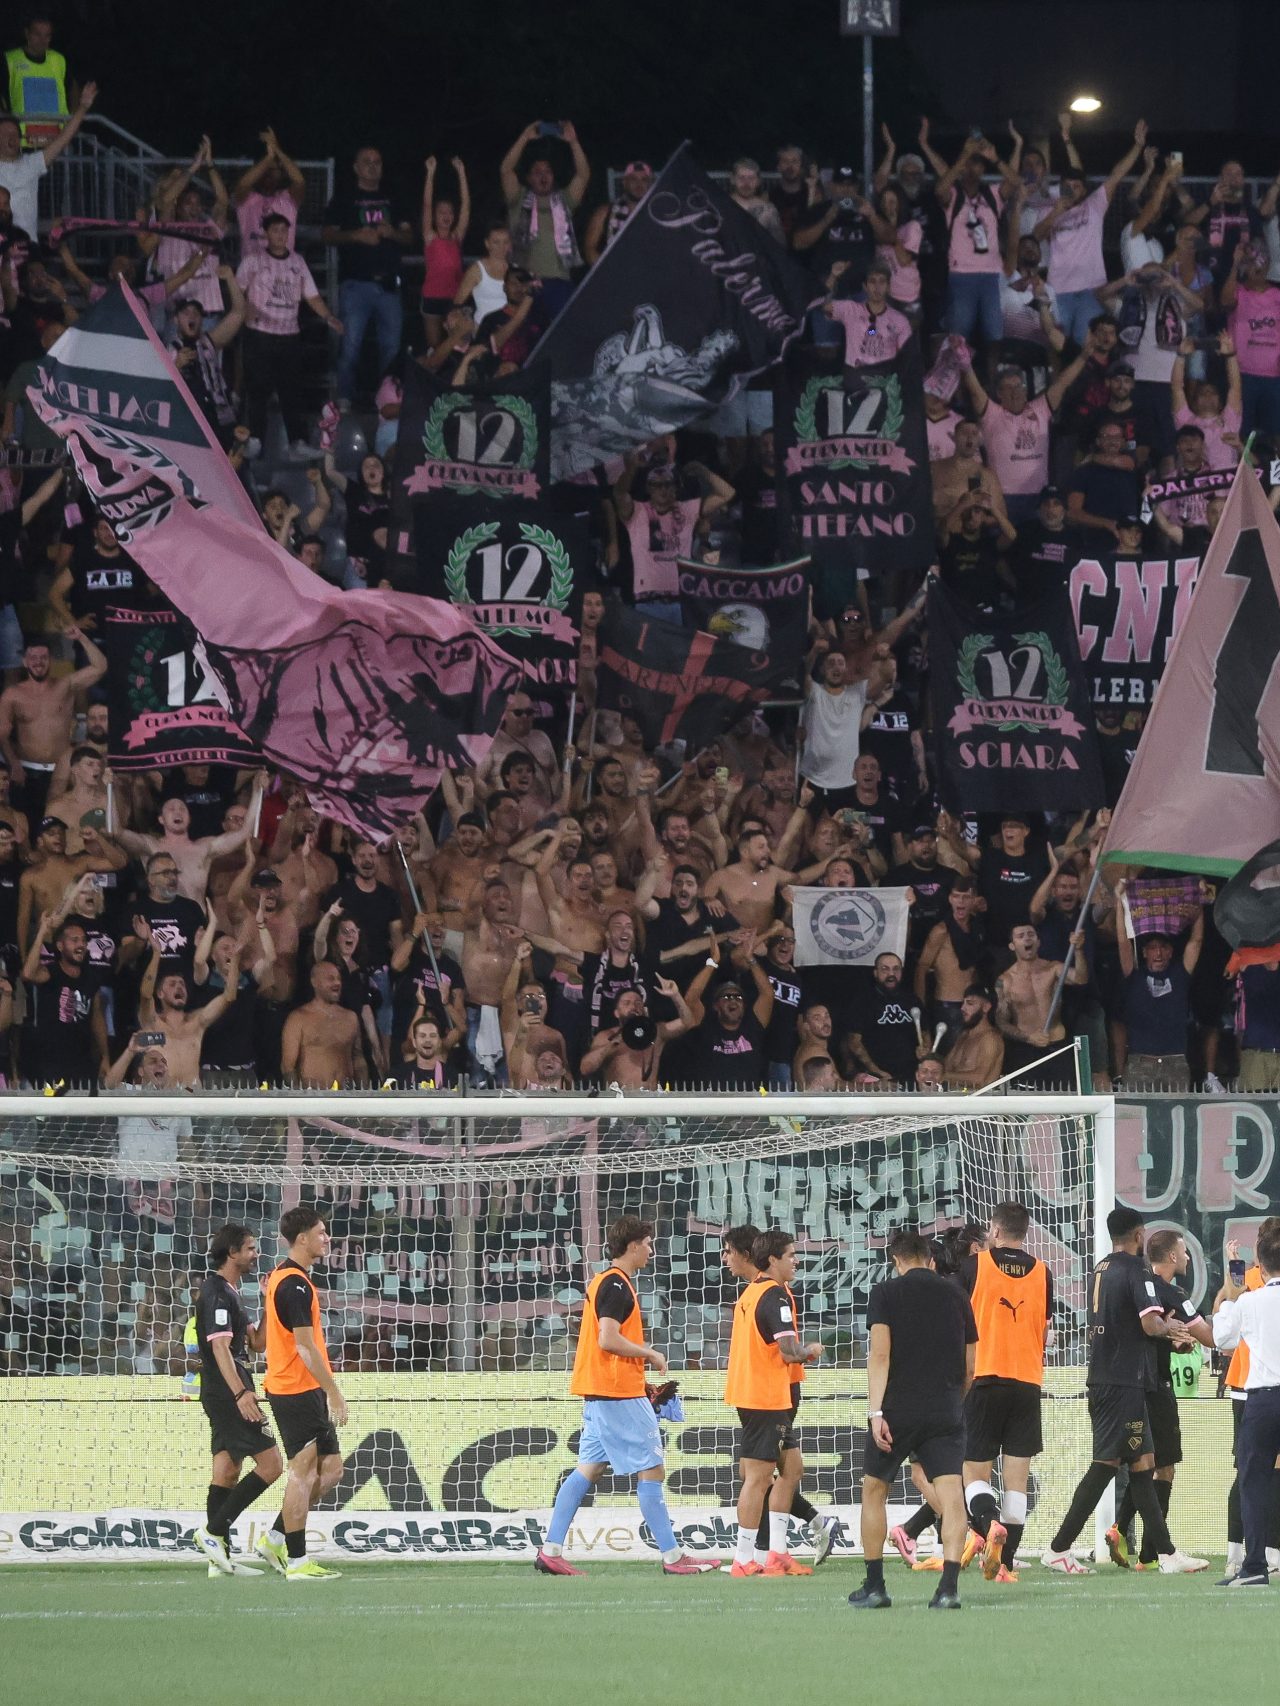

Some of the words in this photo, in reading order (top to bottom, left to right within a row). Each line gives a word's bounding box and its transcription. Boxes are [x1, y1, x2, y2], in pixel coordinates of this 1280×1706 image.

[453, 409, 516, 467] 12
[800, 481, 895, 505] SANTO
[476, 543, 543, 602] 12
[679, 573, 805, 599] CACCAMO
[472, 606, 558, 626] ALERMO
[982, 646, 1043, 700] 12
[968, 702, 1021, 719] CURVA
[1021, 706, 1063, 721] NORD
[959, 742, 1080, 769] SCIARA
[999, 1263, 1026, 1276] HENRY
[1171, 1365, 1195, 1388] 19
[332, 1518, 547, 1554] GoldBet
[567, 1520, 634, 1553] ive
